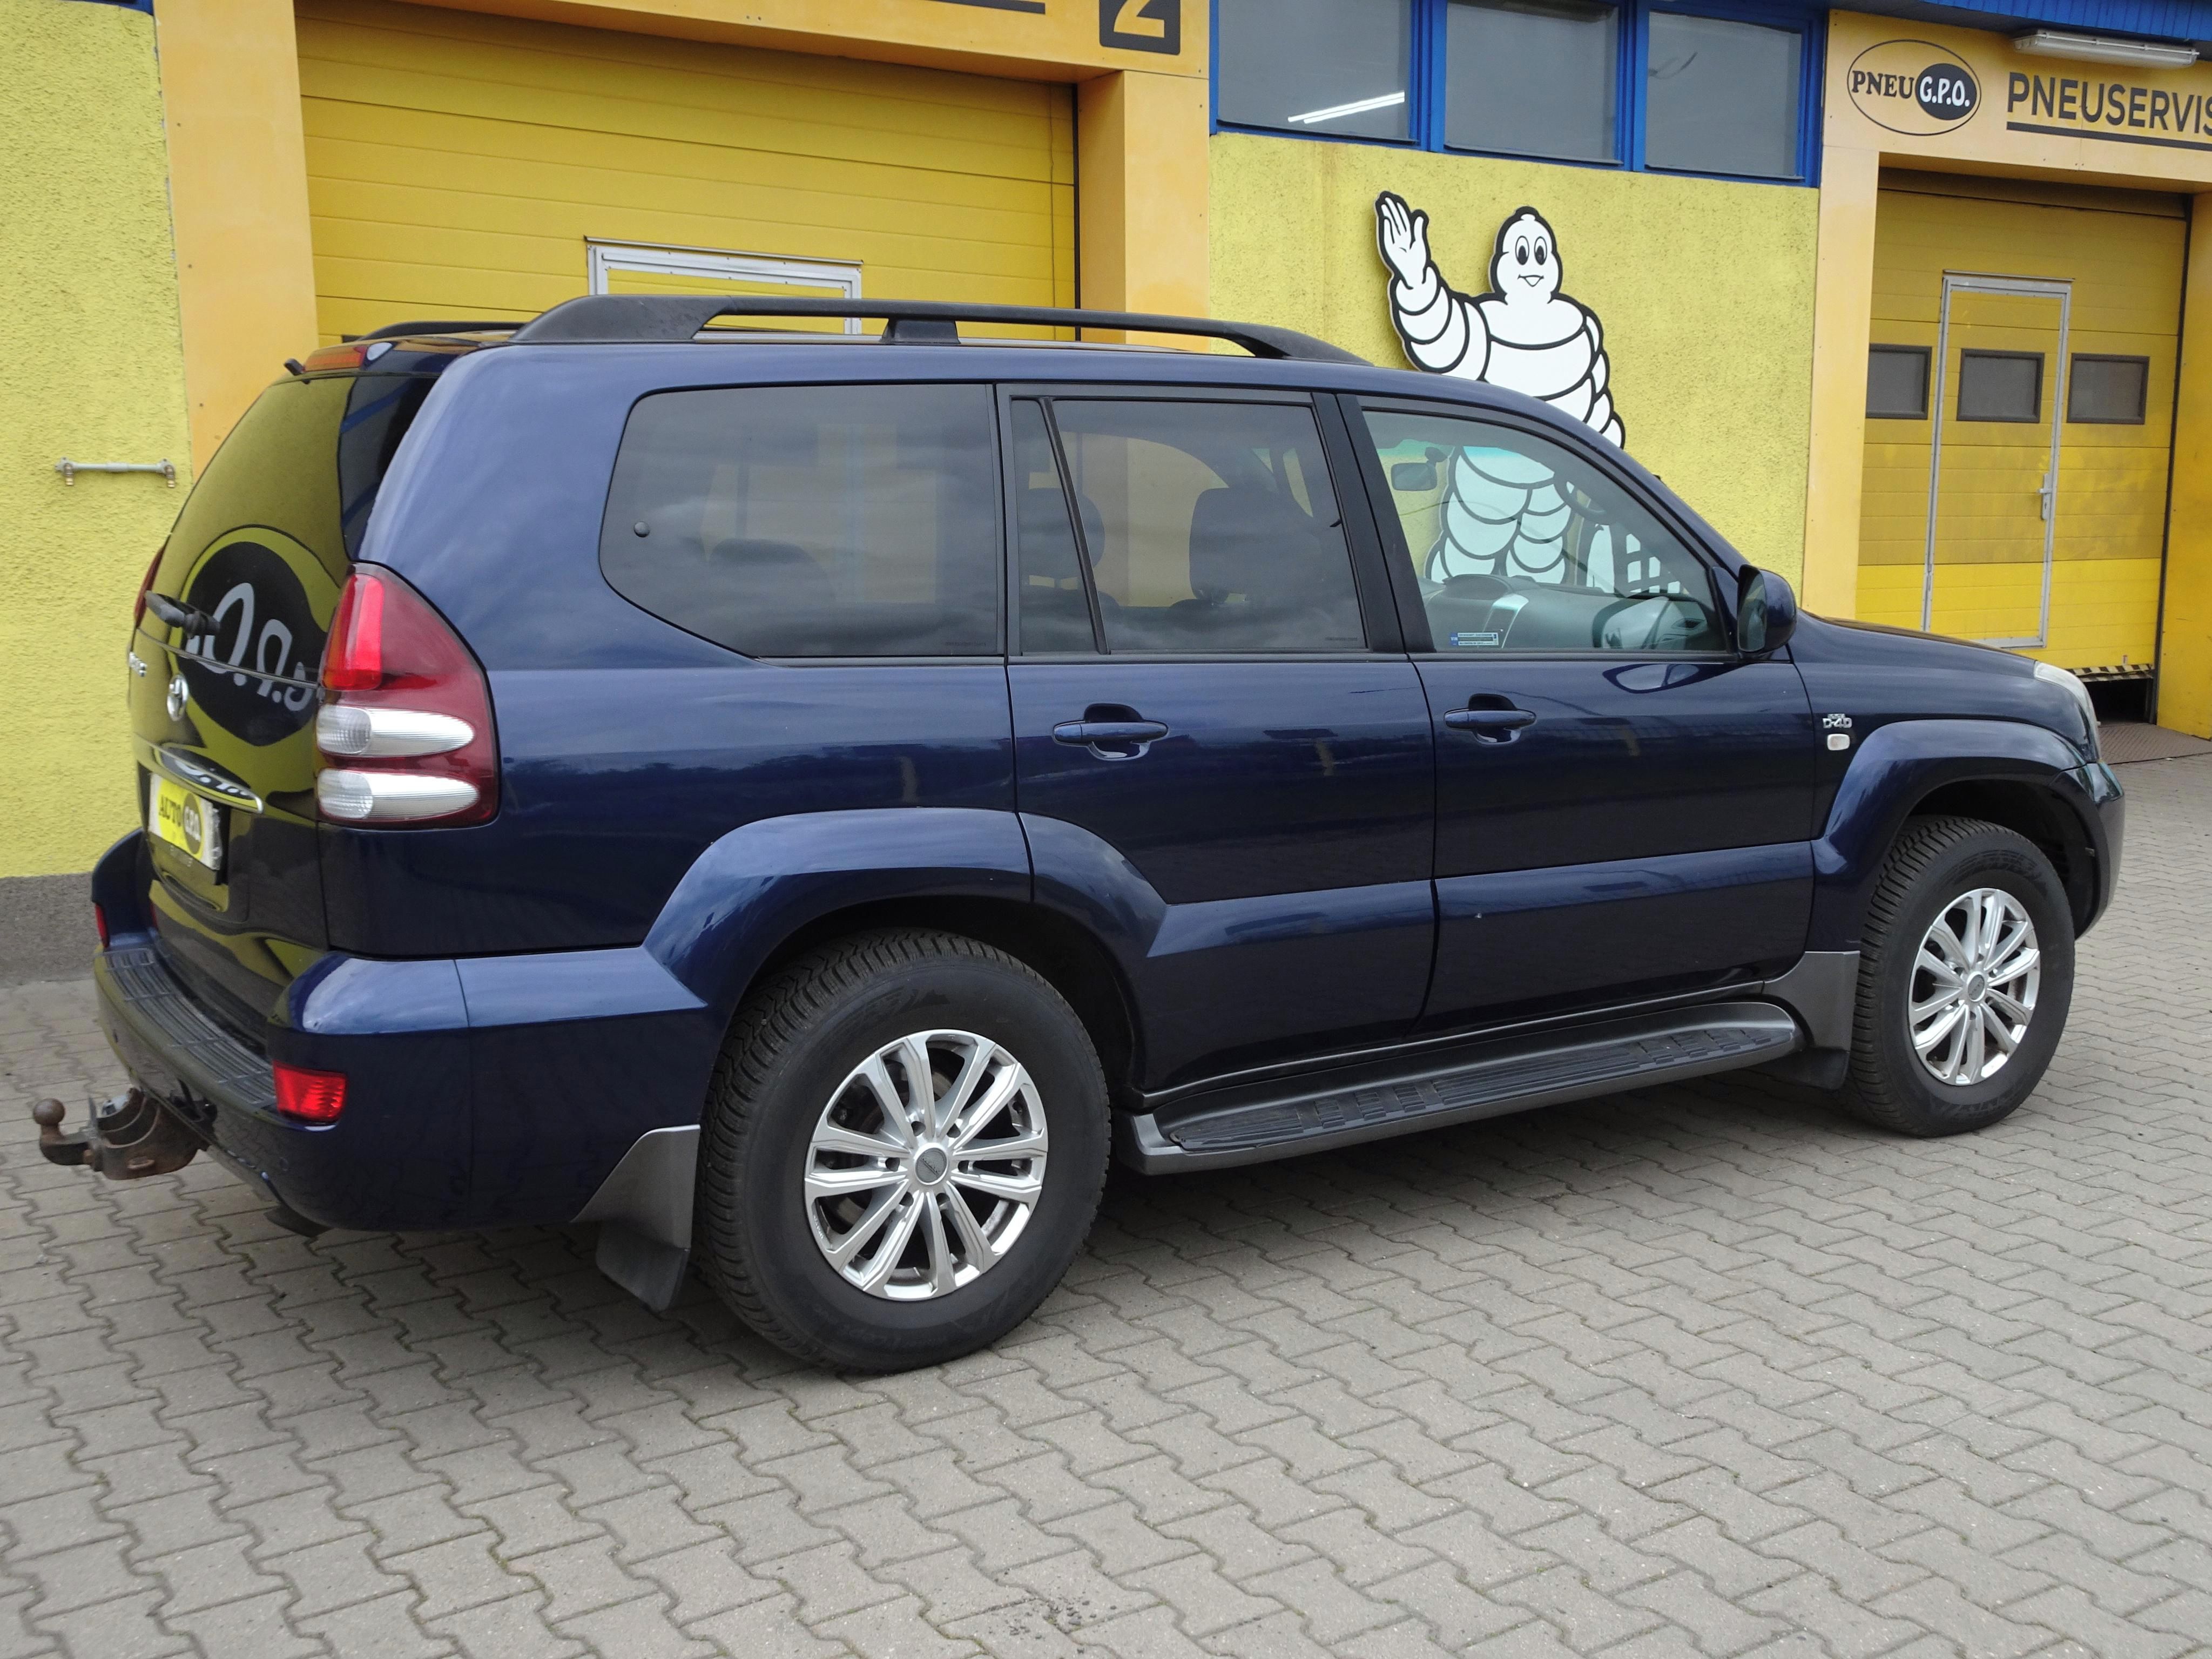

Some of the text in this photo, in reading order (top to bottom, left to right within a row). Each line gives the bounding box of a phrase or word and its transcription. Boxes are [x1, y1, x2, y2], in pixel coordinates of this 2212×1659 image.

[1852, 70, 1971, 107] PNEU G.P.O.
[1823, 717, 1852, 729] D-4D
